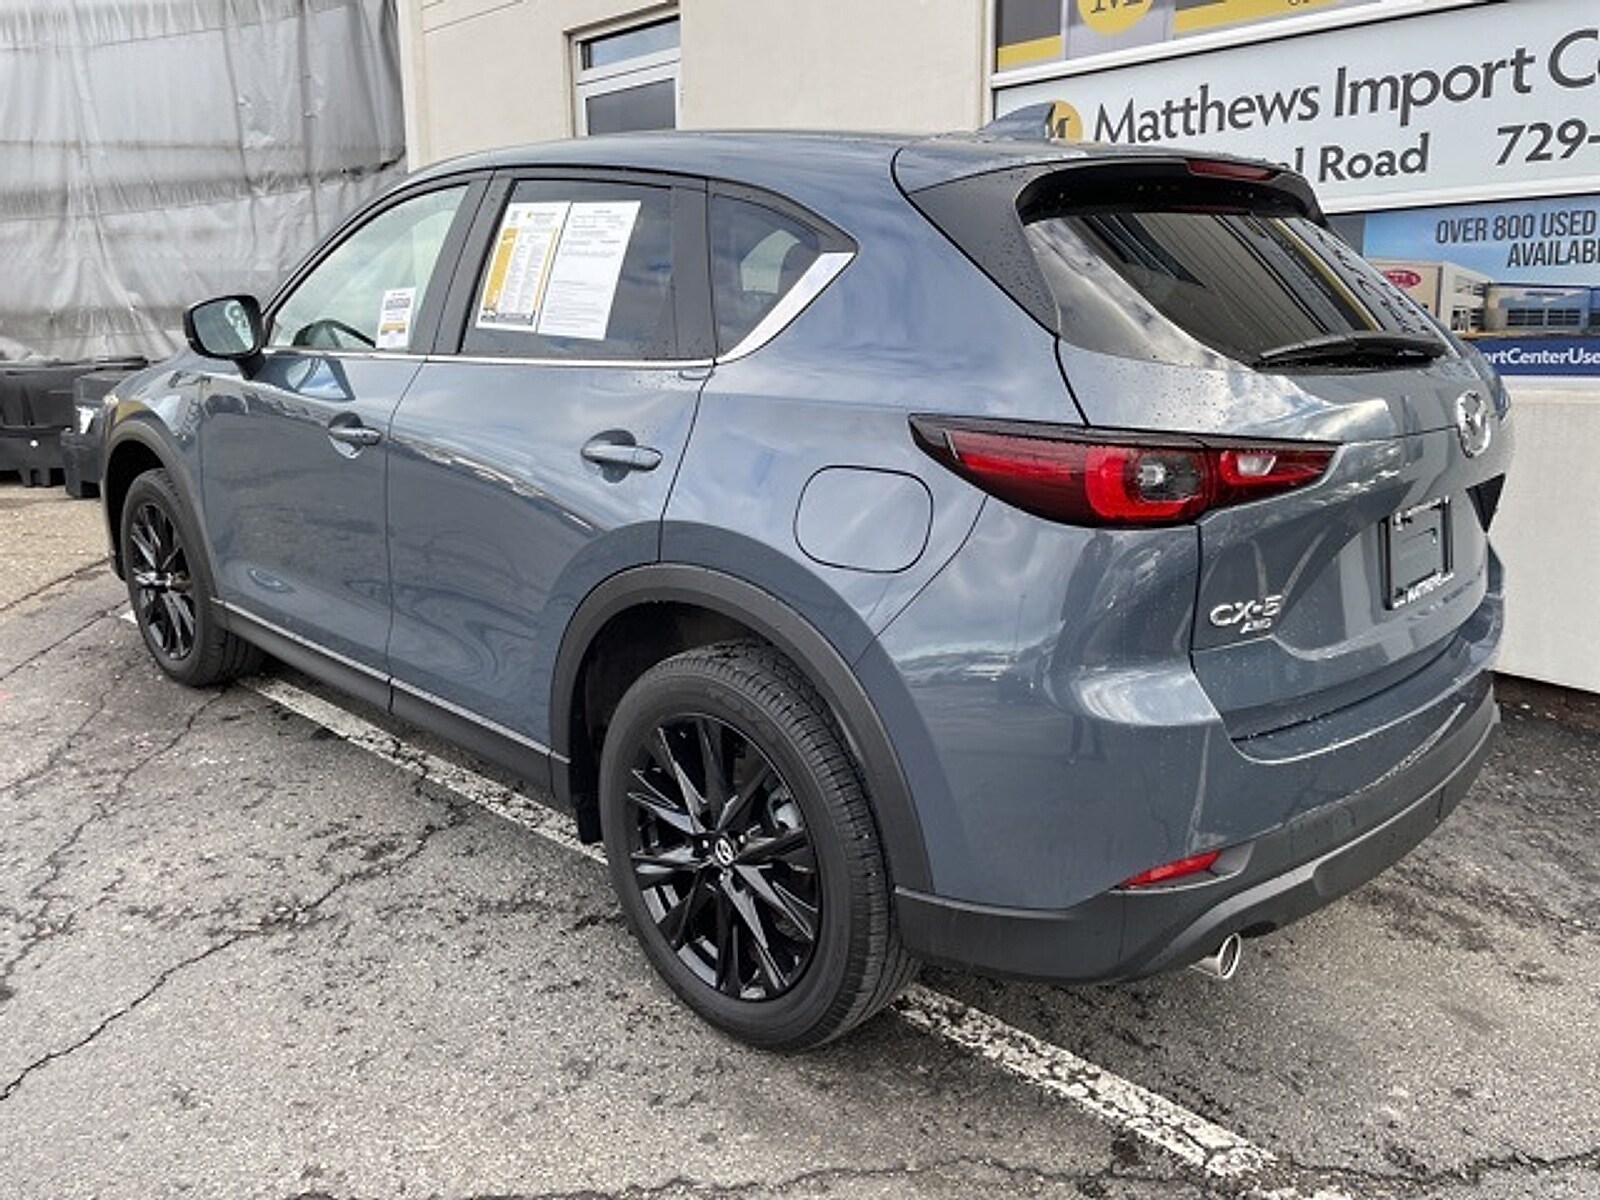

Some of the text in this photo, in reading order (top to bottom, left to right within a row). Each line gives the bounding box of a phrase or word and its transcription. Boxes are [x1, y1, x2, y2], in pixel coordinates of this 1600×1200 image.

[1095, 28, 1600, 144] Matthews Import C
[1318, 132, 1430, 183] Road
[1436, 210, 1597, 244] OVER 800 USED
[1209, 595, 1283, 627] CX-5
